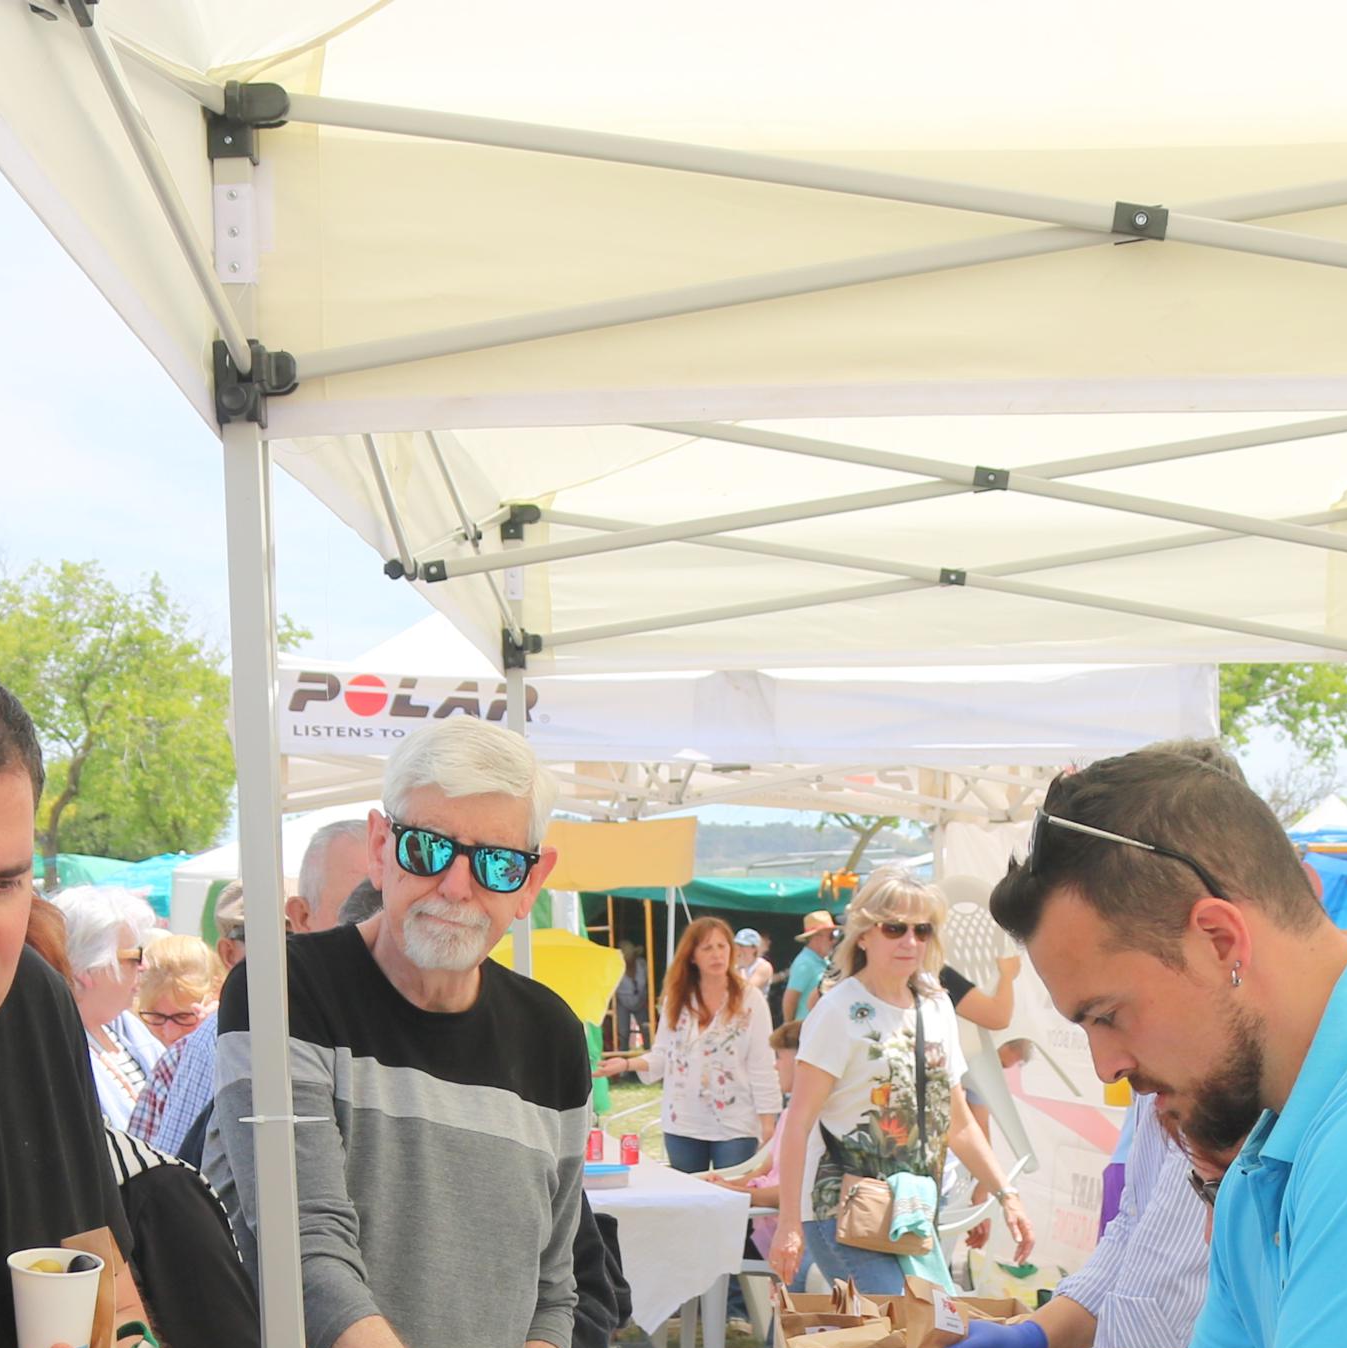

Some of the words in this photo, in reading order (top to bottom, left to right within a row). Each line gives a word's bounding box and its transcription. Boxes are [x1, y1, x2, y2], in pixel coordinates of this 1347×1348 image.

[288, 671, 538, 722] POLAR
[293, 724, 374, 739] LISTENS
[376, 728, 405, 738] TO
